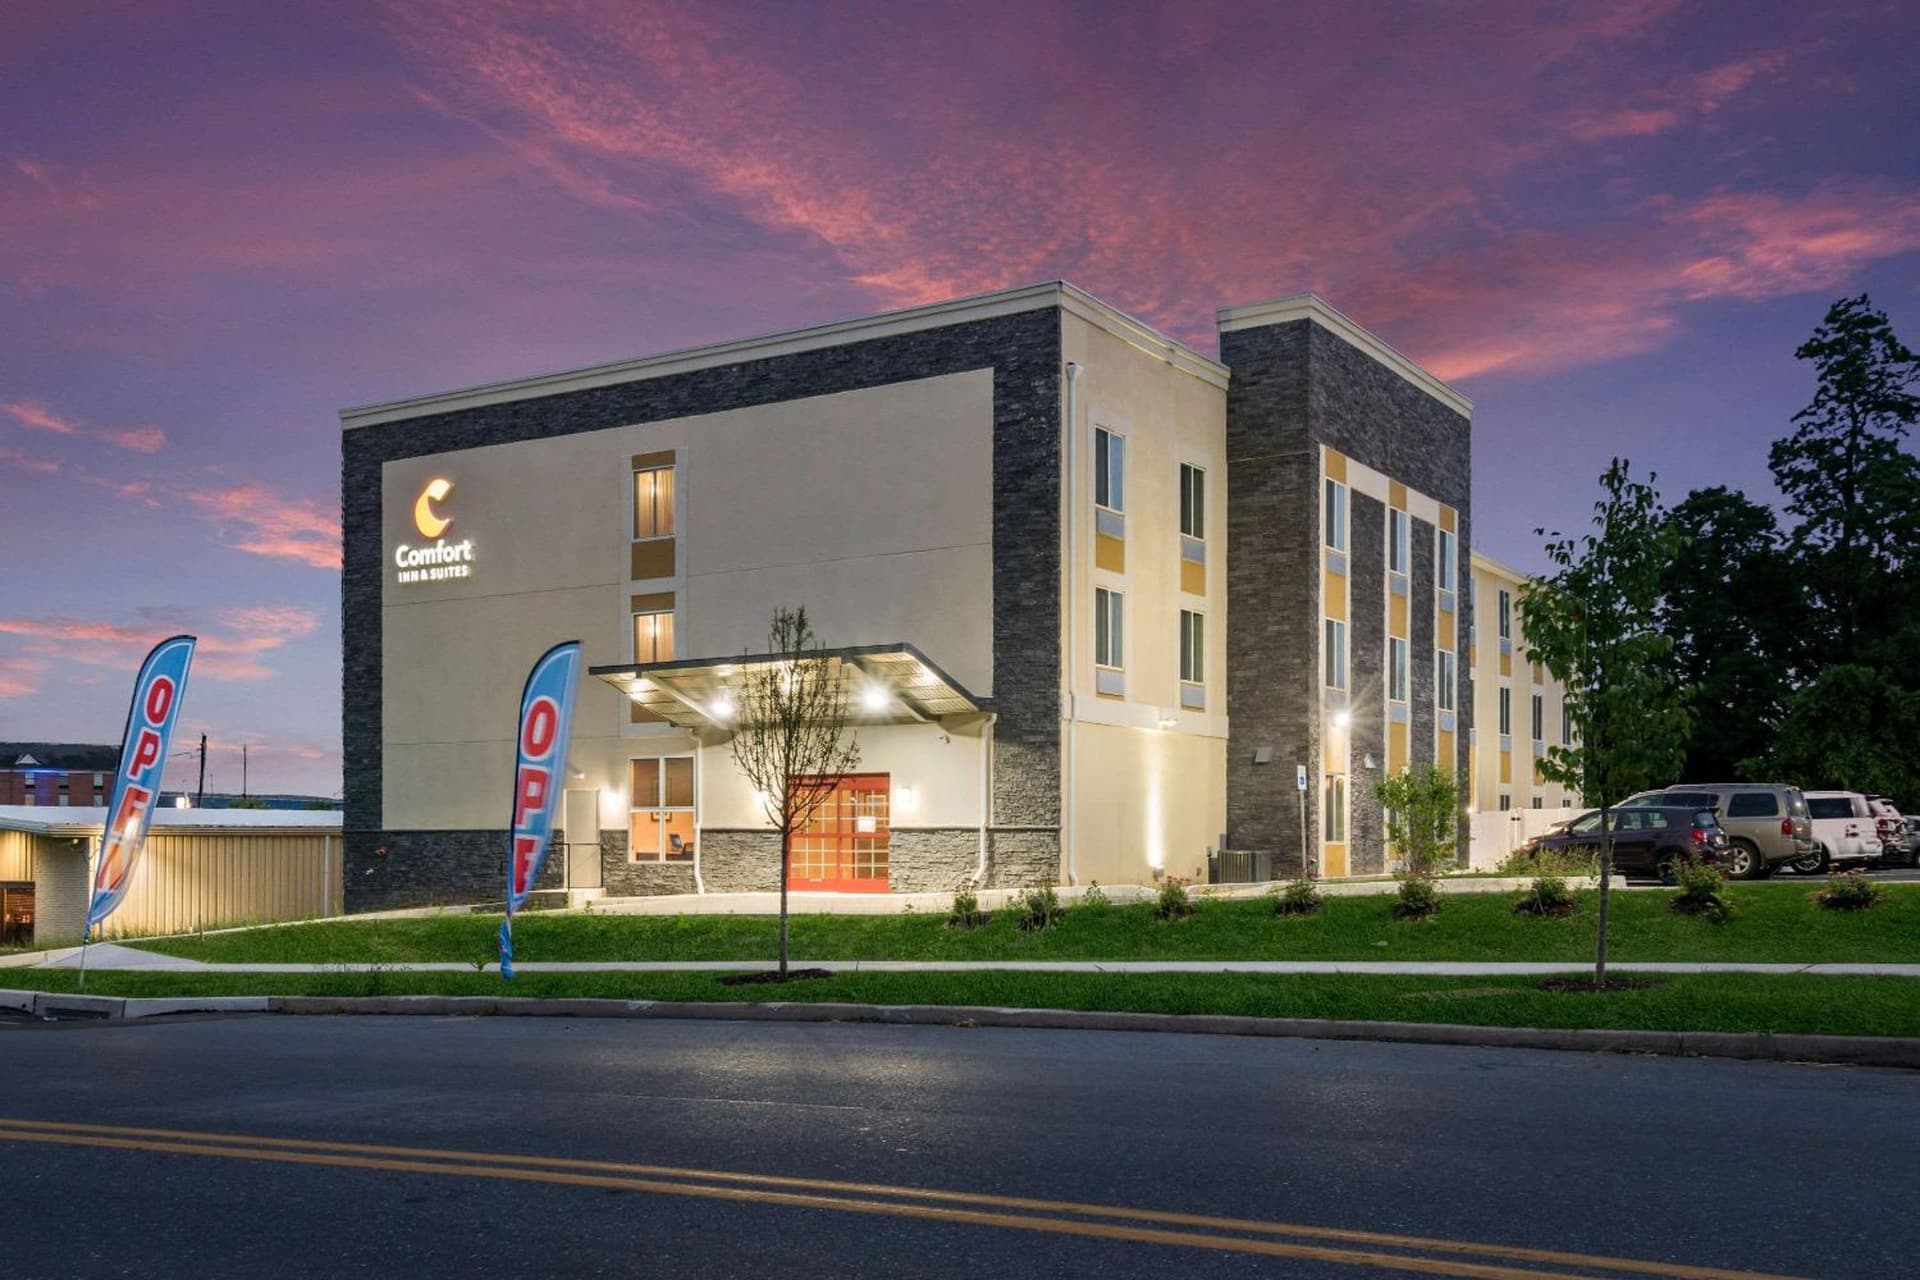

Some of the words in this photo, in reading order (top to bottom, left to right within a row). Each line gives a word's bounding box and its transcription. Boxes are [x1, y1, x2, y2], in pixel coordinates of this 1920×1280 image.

[395, 538, 473, 568] Comfort
[398, 570, 419, 583] INN
[429, 564, 469, 580] SUITES
[512, 696, 560, 895] OPE
